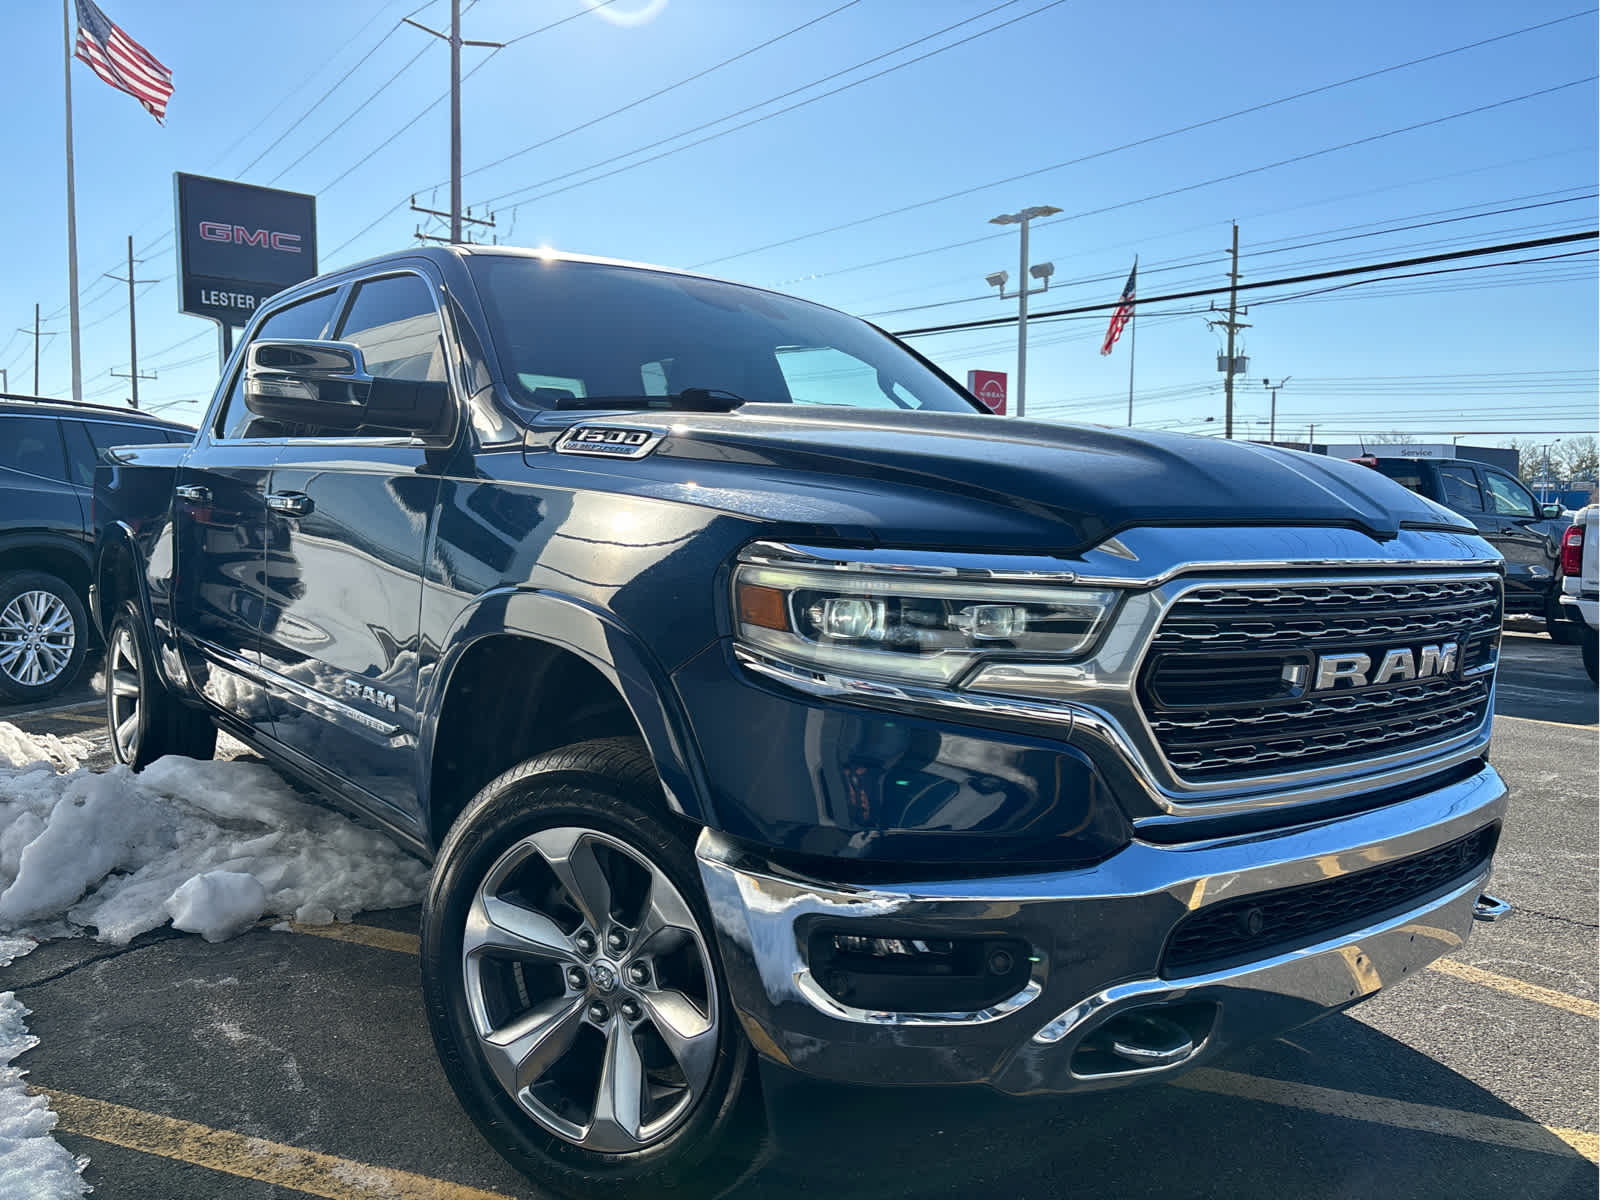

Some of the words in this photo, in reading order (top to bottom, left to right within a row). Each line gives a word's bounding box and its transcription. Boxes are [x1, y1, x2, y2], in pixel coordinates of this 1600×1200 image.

[200, 221, 301, 253] GMC
[201, 289, 256, 310] LESTER
[577, 428, 648, 445] 1500
[1401, 448, 1433, 457] Service
[1315, 642, 1458, 690] RAM
[345, 679, 397, 713] RAM
